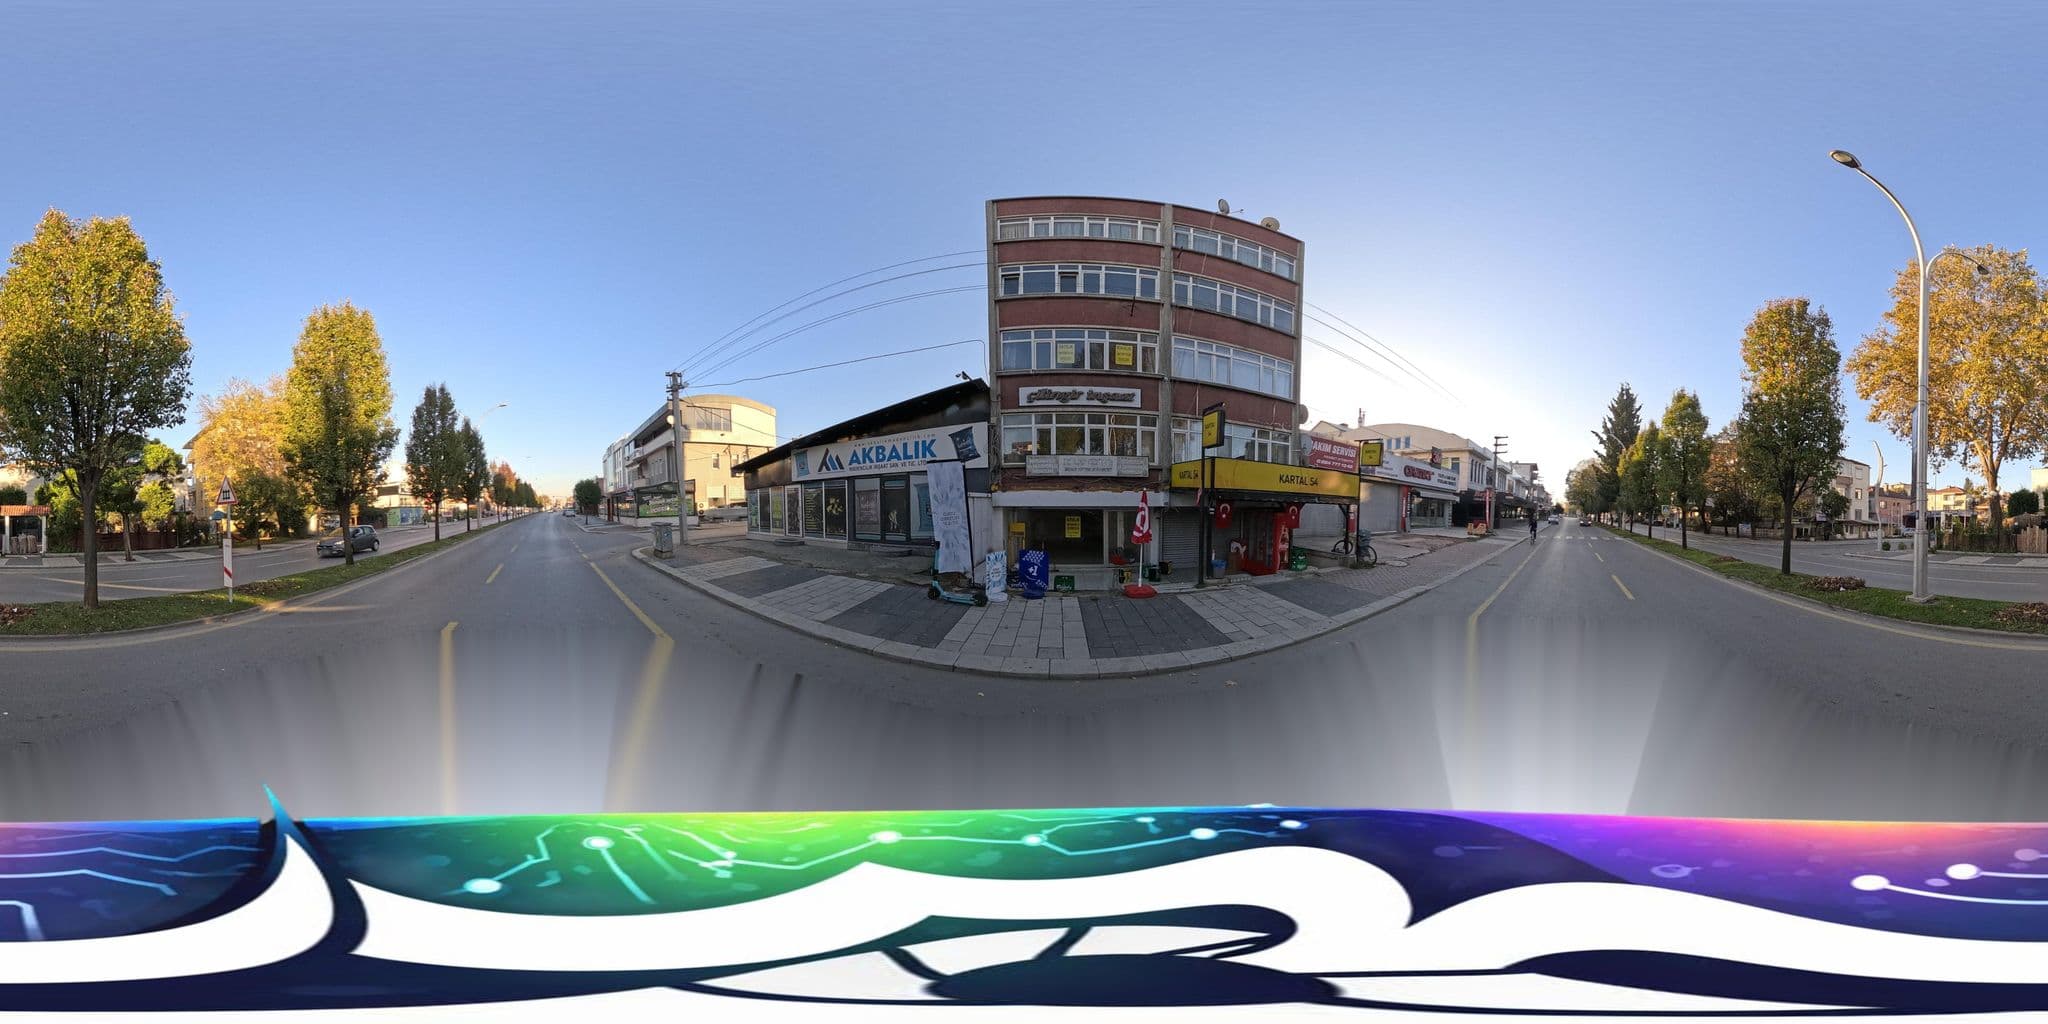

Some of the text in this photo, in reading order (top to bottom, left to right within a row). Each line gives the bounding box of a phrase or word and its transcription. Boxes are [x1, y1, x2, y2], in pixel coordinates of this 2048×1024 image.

[848, 438, 937, 466] AKBALIK
[1311, 440, 1357, 458] AKIM SERVİSİ
[1279, 473, 1319, 487] KARTAL 54
